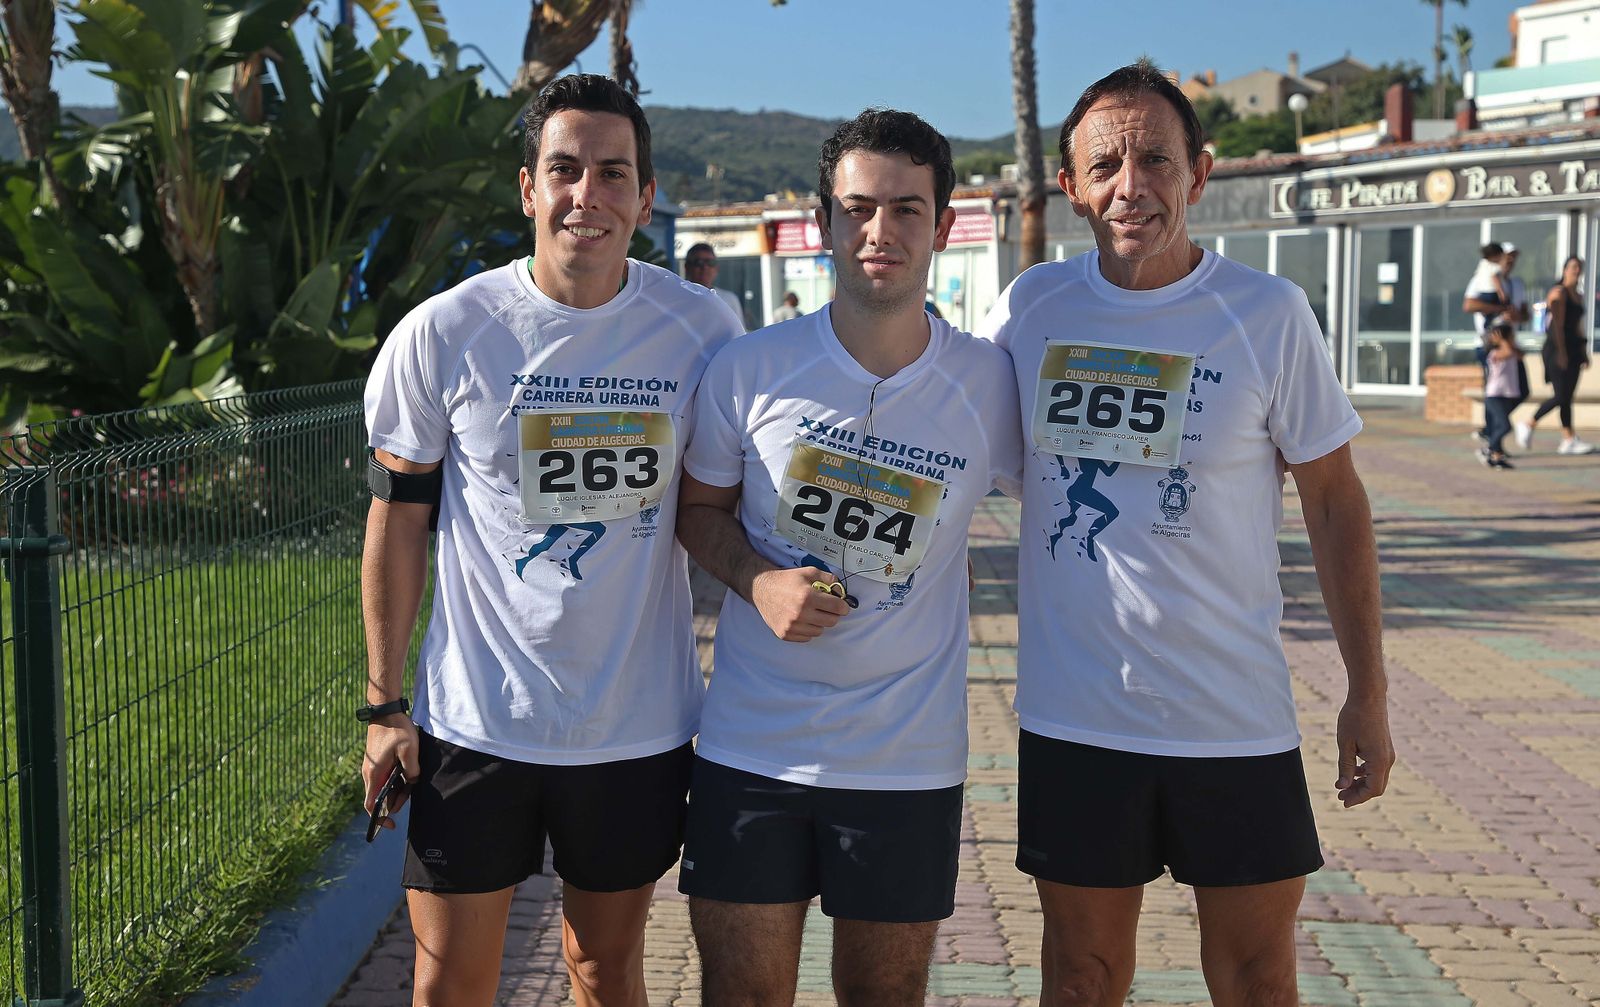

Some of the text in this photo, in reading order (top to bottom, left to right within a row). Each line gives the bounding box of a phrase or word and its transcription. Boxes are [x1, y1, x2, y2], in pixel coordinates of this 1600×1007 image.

[1529, 170, 1553, 196] &
[1068, 348, 1087, 358] XXIII
[509, 374, 678, 393] XXIII EDICIÓN
[1066, 369, 1158, 387] CIUDAD DE ALGECIRAS
[522, 389, 660, 406] CARRERA URBANA
[1046, 382, 1168, 434] 265
[550, 416, 571, 426] XXIII
[551, 434, 646, 448] CIUDAD DE ALGECIRAS
[797, 415, 856, 444] XXIII
[863, 434, 967, 471] EDICIÓN
[1092, 431, 1126, 440] FRANCISCO
[821, 454, 843, 468] XXIII
[538, 447, 659, 493] 263
[815, 475, 850, 492] CIUDAD
[850, 484, 862, 496] DE
[862, 487, 910, 510] ALGECIRAS
[791, 485, 916, 556] 264
[1152, 522, 1191, 532] Ayuntamiento
[1160, 530, 1190, 538] Algeciras
[848, 545, 868, 554] PABLO
